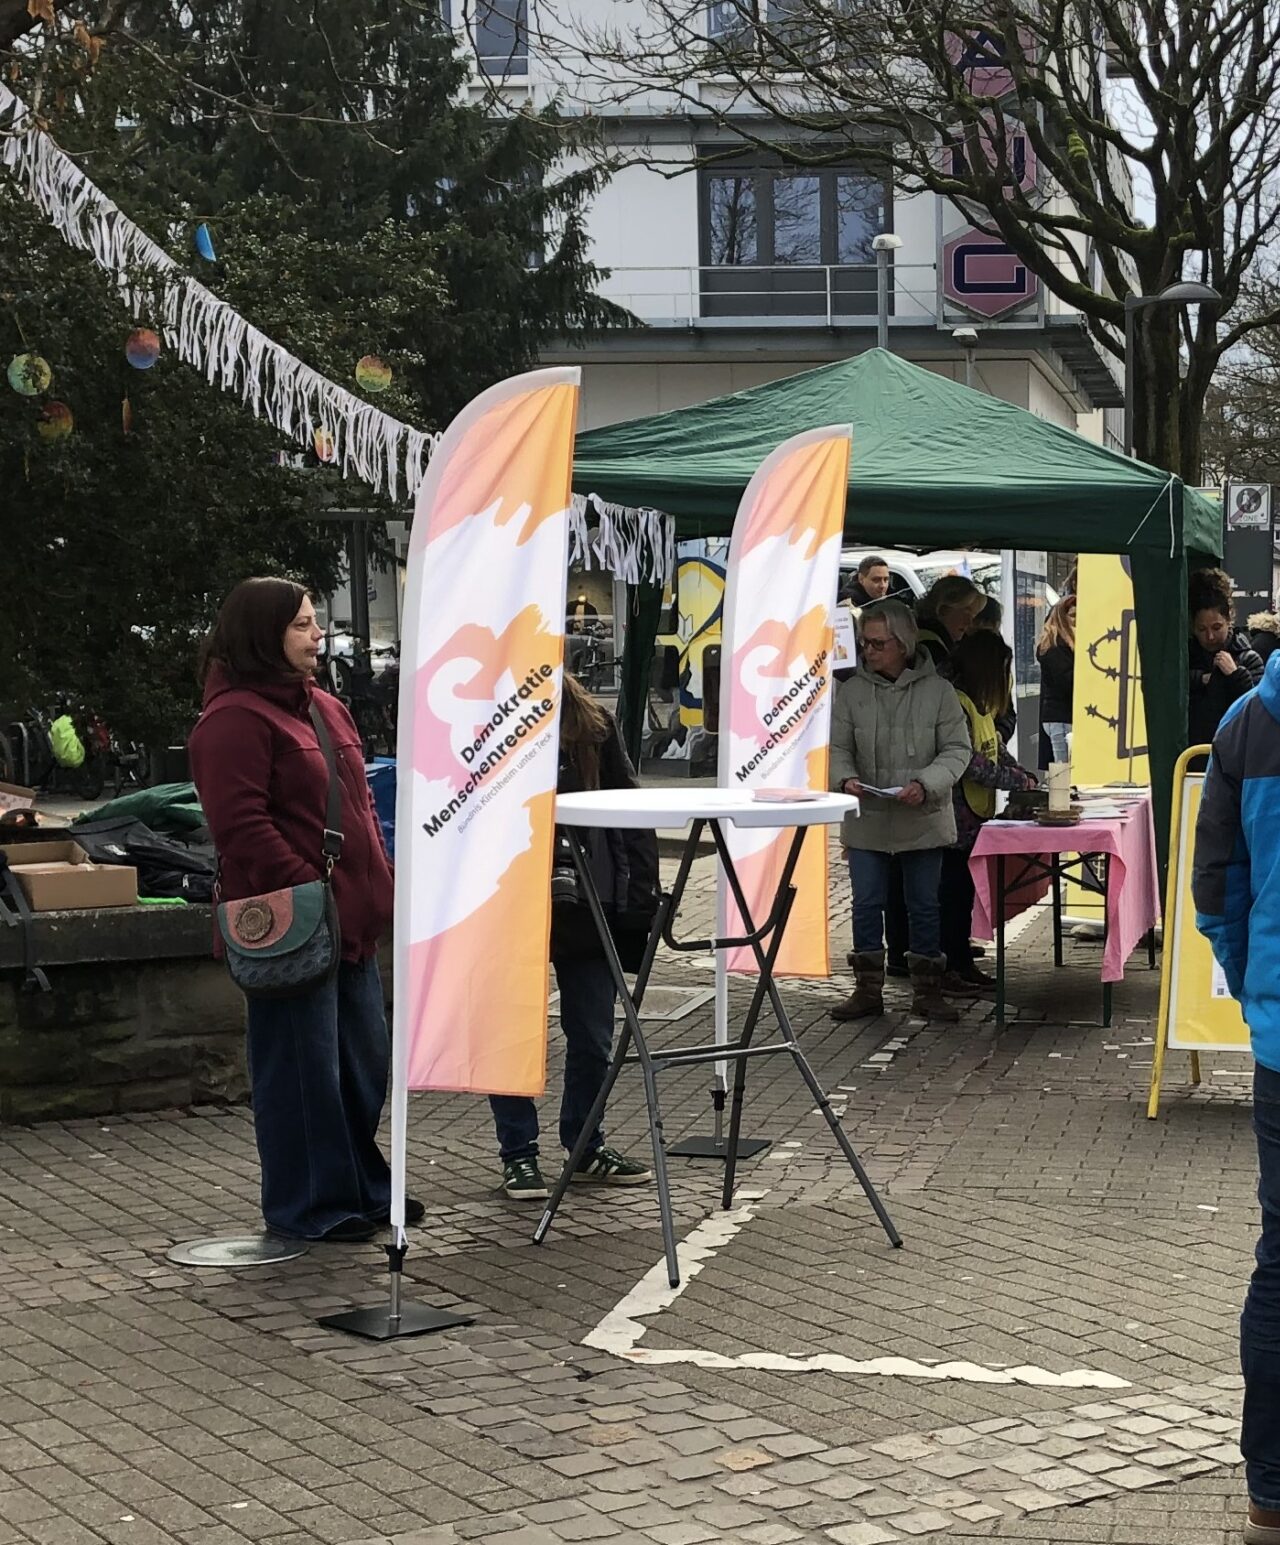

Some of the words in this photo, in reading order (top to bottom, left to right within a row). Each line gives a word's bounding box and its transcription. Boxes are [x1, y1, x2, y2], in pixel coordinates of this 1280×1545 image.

[460, 663, 552, 764] Demokratie
[516, 746, 538, 771] unter
[533, 732, 553, 752] Teck
[735, 676, 826, 783] Menschenrechte
[422, 698, 553, 838] Menschenrechte
